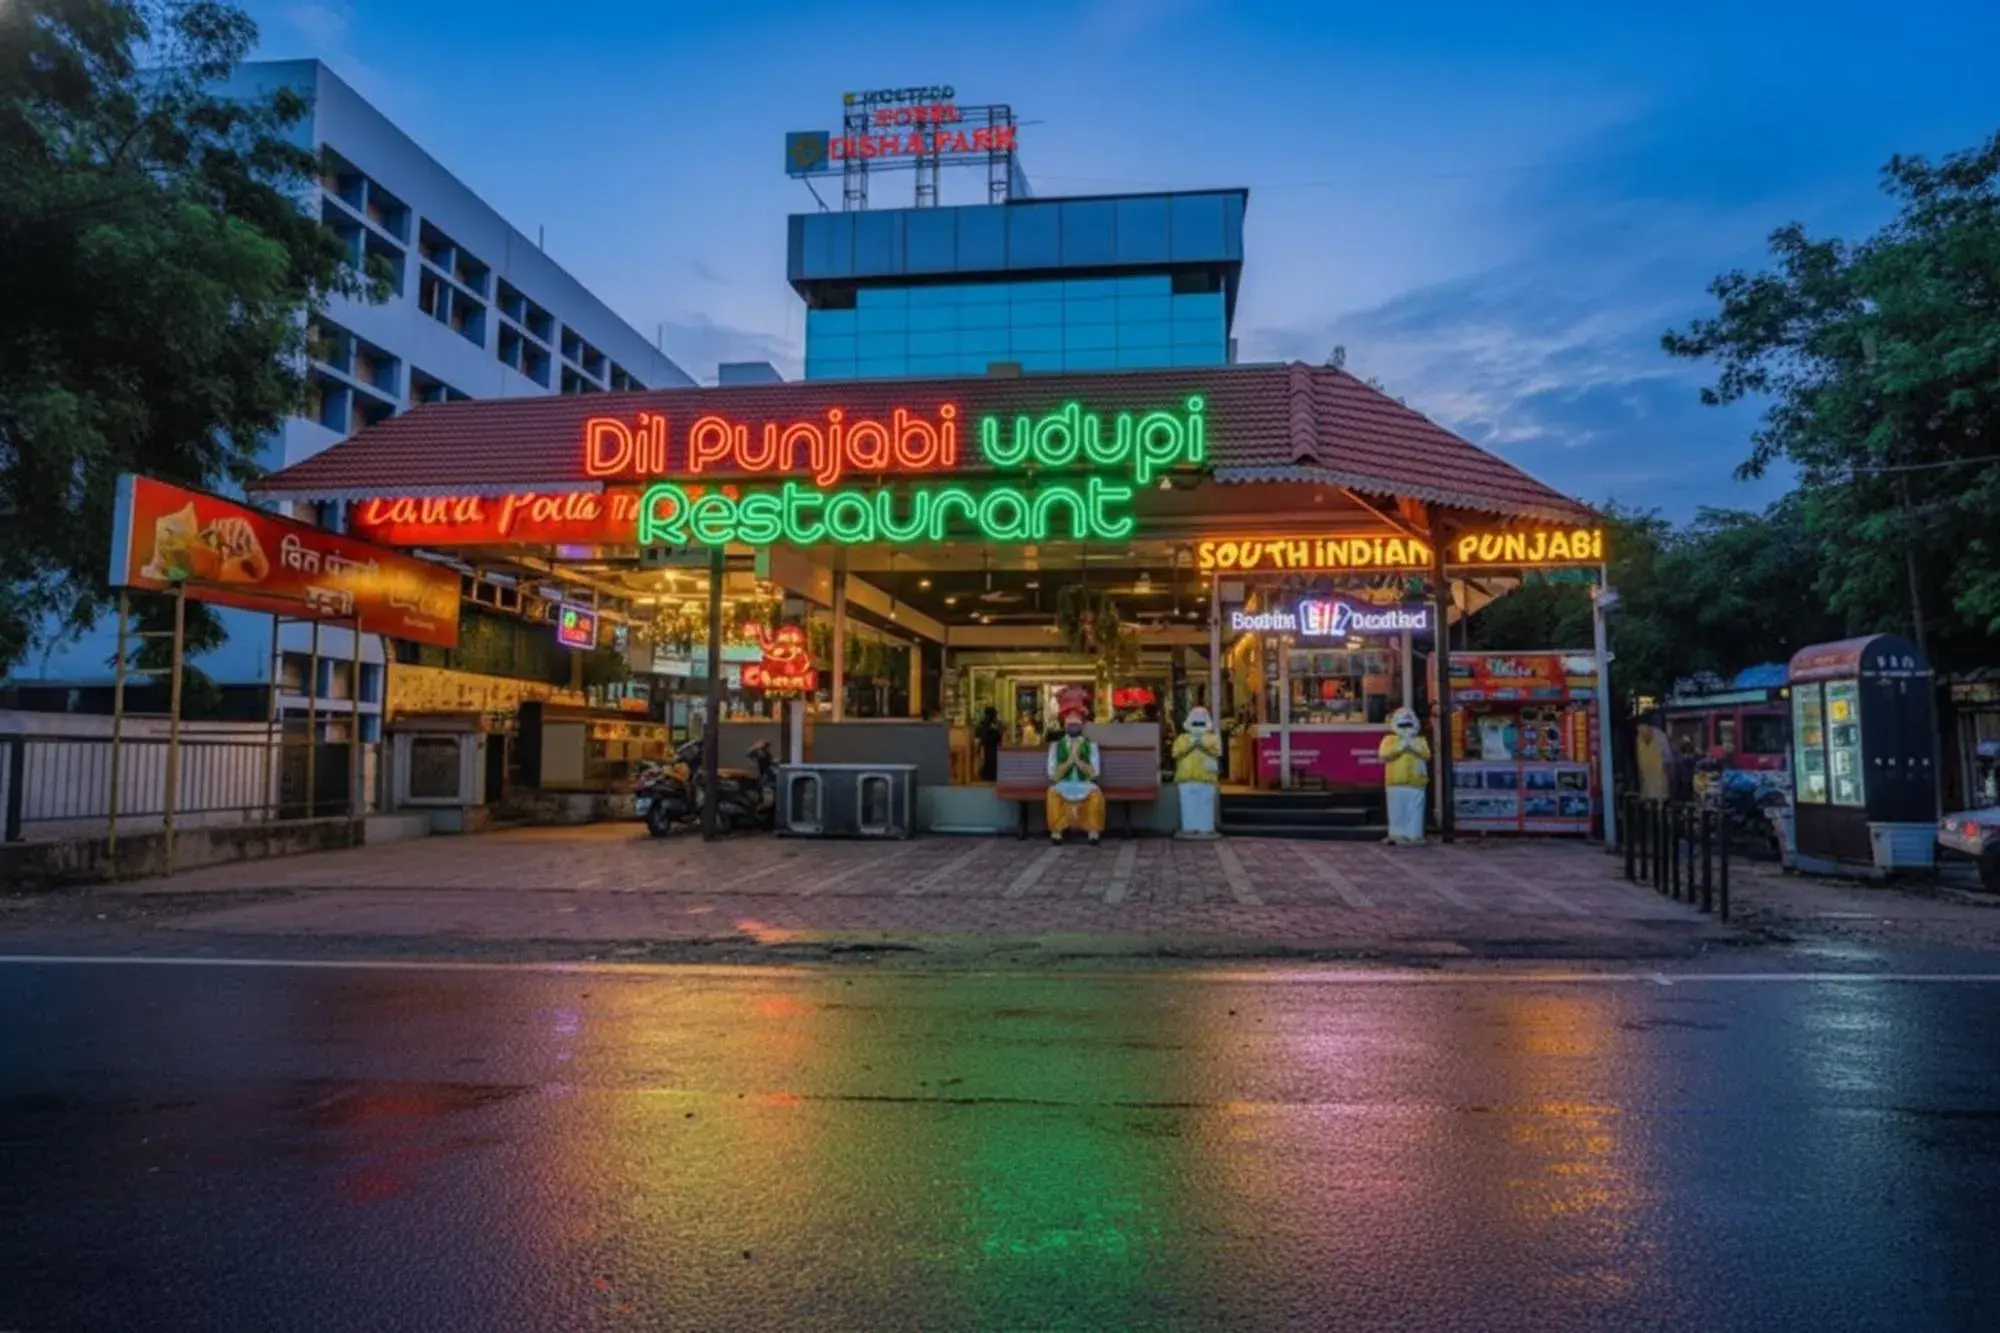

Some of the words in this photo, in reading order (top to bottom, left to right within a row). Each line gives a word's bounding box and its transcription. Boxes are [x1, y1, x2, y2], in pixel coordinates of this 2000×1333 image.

[586, 415, 665, 476] Dil
[689, 404, 957, 486] Punjabi
[981, 396, 1204, 484] udupi
[639, 477, 1134, 546] Restaurant
[1198, 541, 1309, 569] SOUTH
